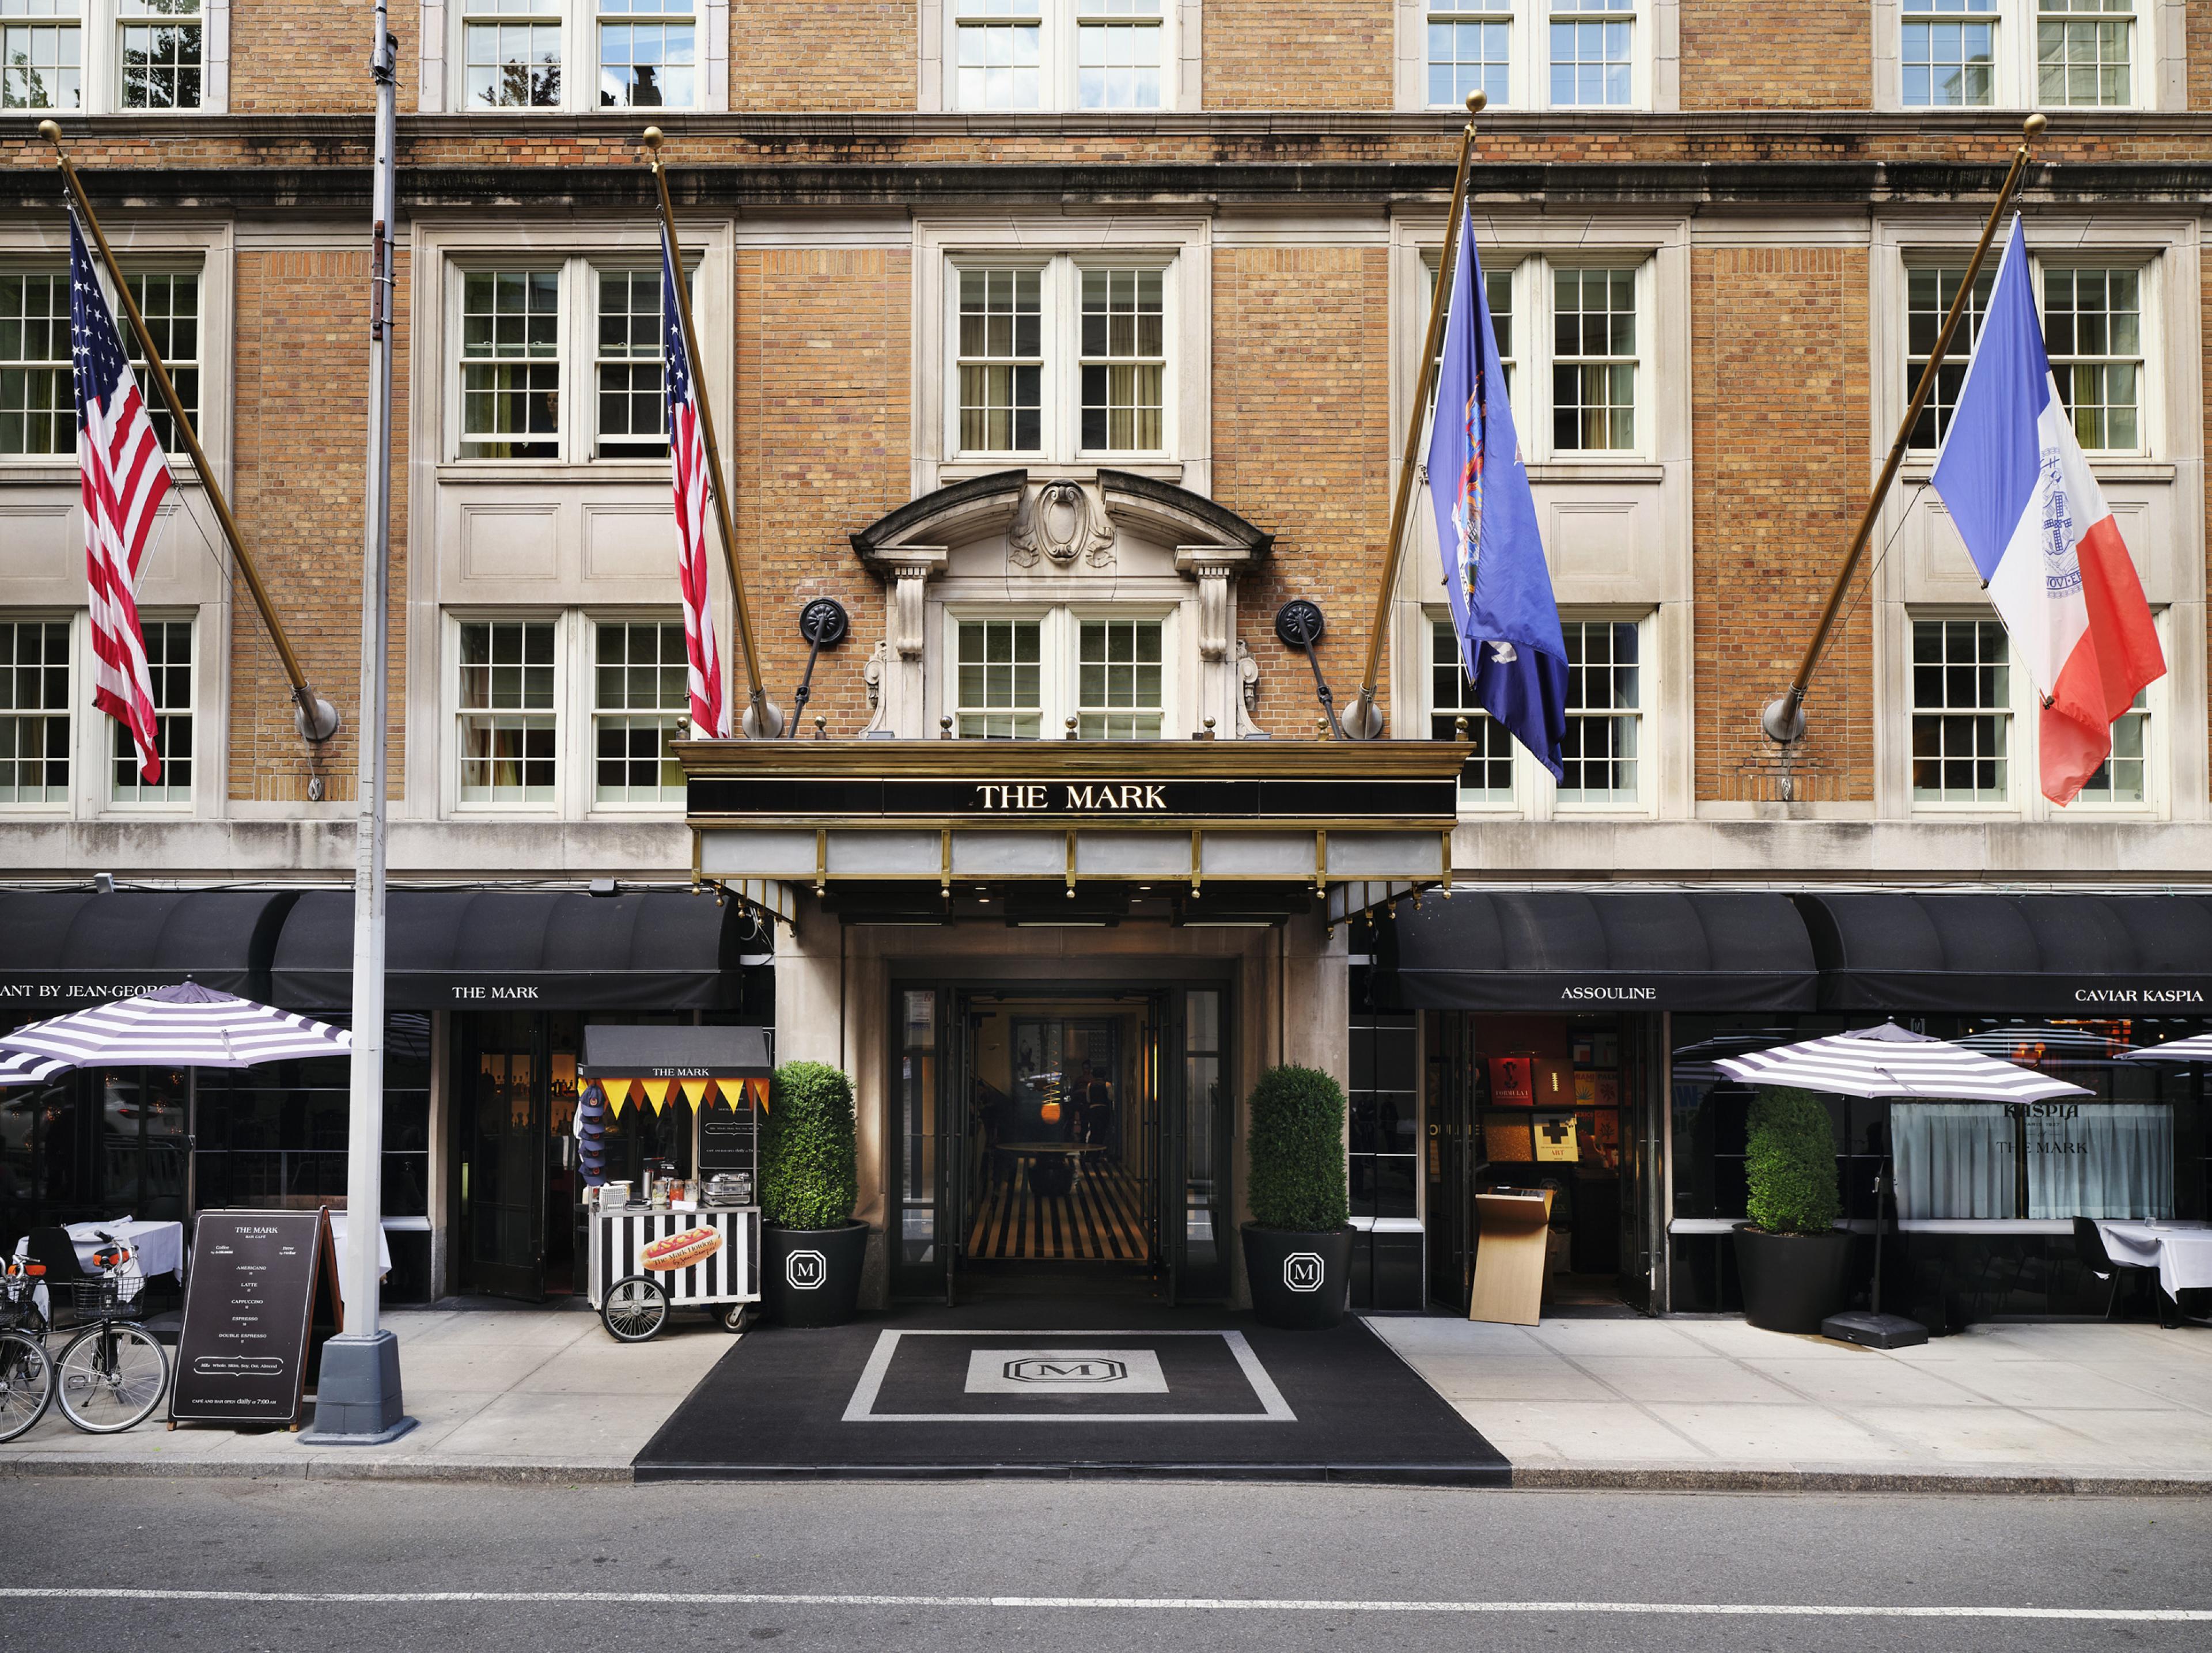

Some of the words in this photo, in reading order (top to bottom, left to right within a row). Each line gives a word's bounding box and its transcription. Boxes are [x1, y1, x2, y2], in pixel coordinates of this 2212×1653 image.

[976, 786, 1048, 809] THE
[1066, 786, 1167, 809] MARK
[39, 985, 61, 996] BY
[452, 987, 486, 998] THE
[491, 987, 539, 998] MARK
[1561, 987, 1656, 999] ASSOULINE
[2075, 989, 2138, 1002] CAVIAR
[2143, 989, 2204, 1002] KASPIA
[653, 1068, 675, 1076] THE
[677, 1068, 709, 1076] MARK
[2036, 1142, 2088, 1154] MARK
[669, 1250, 687, 1260] Mark
[798, 1263, 815, 1277] M
[1294, 1264, 1314, 1280] M
